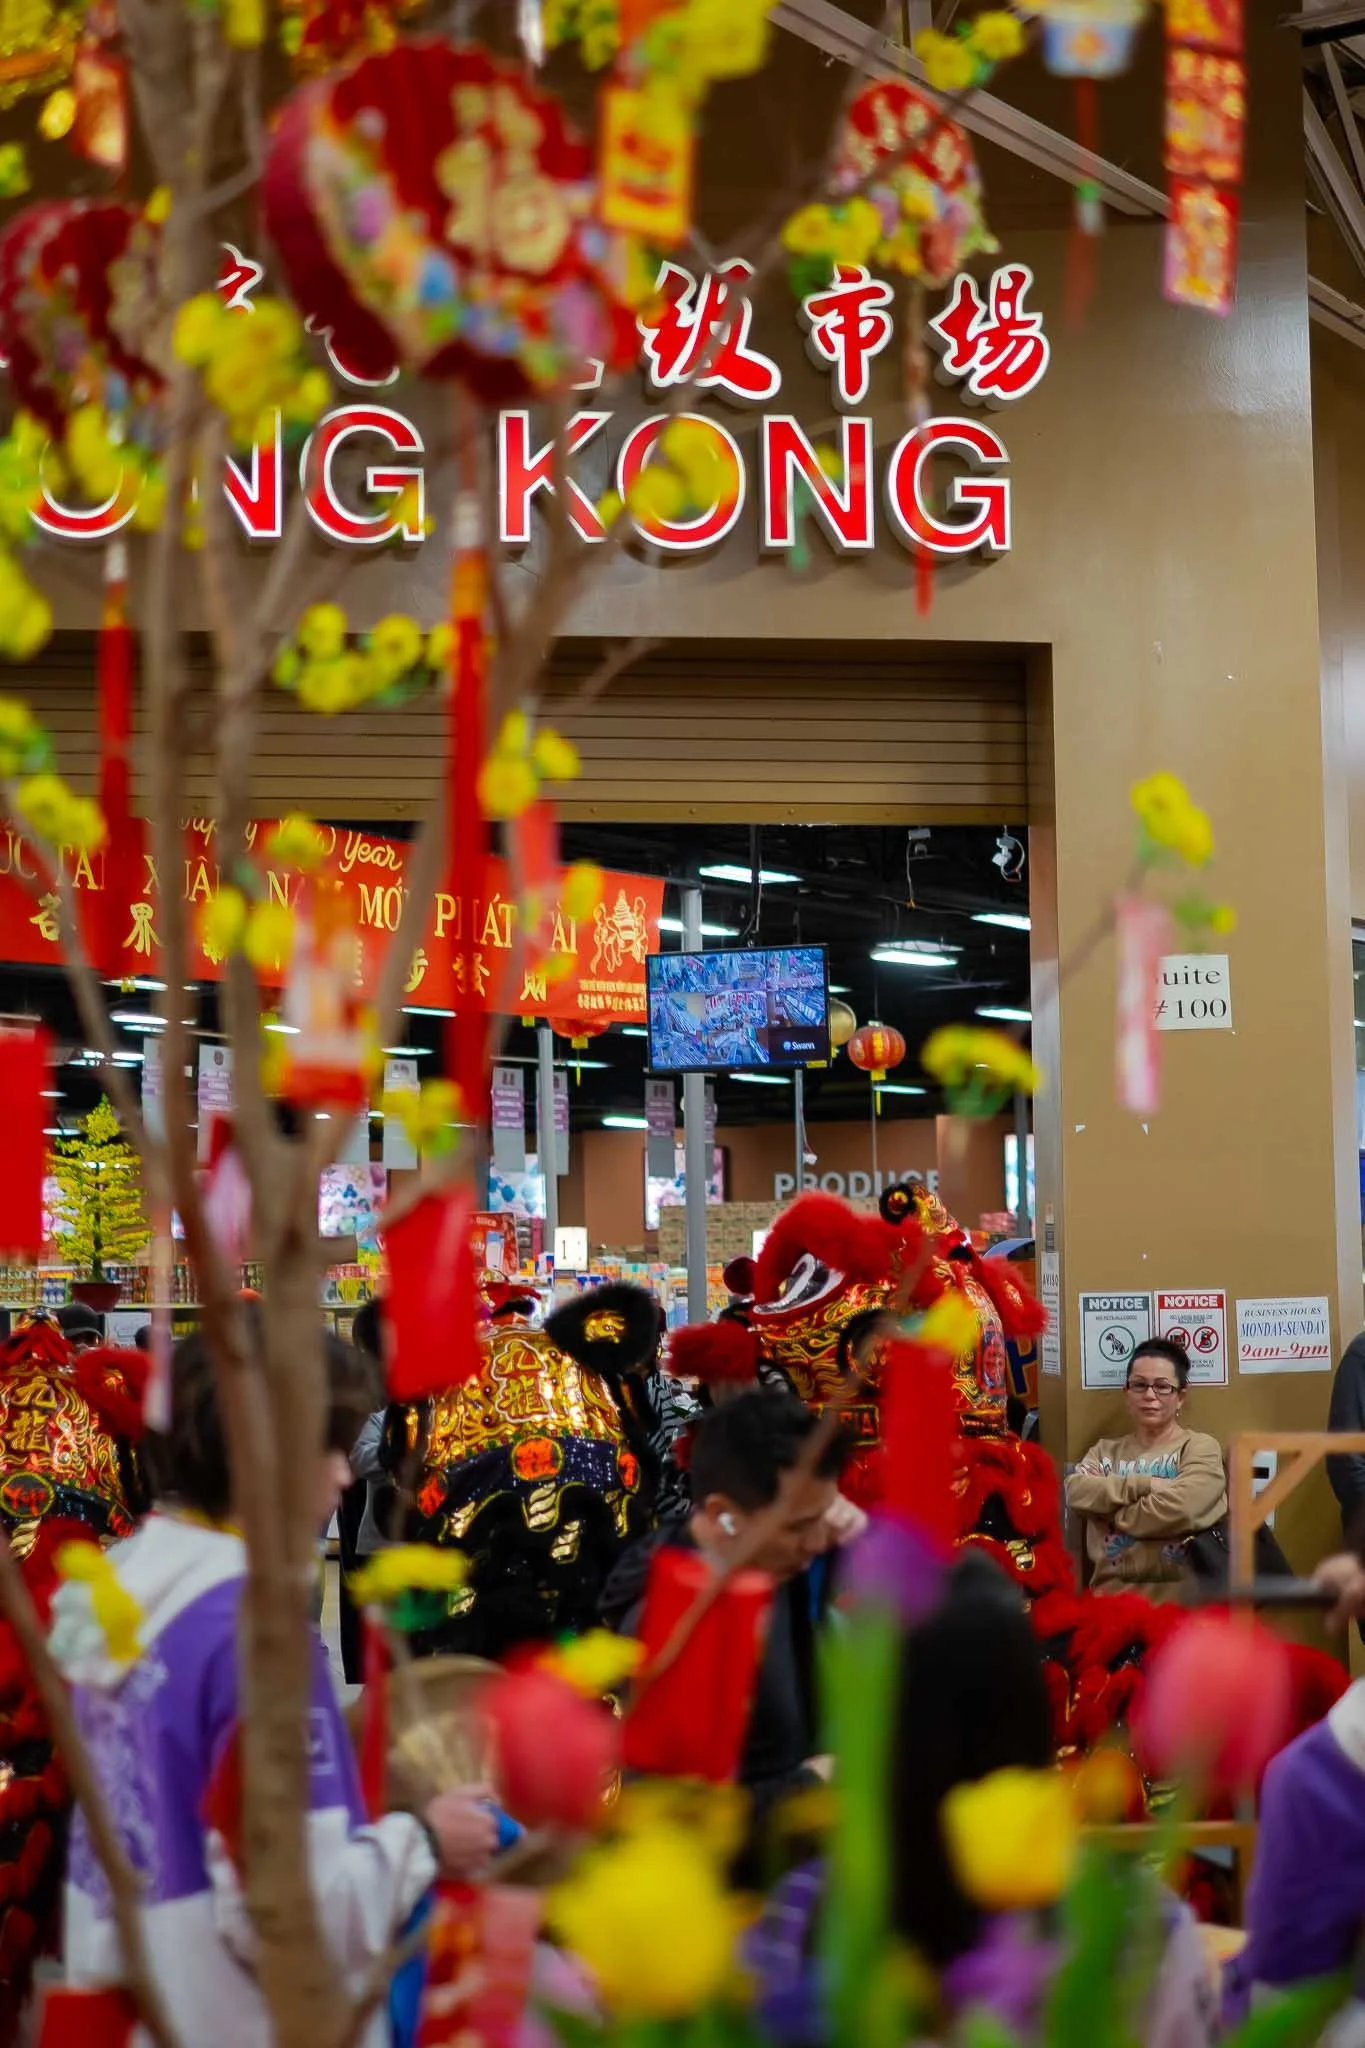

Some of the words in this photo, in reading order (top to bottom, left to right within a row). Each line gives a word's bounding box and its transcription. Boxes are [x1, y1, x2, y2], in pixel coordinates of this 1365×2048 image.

[499, 409, 1013, 554] KONG
[339, 830, 402, 873] Year
[1155, 964, 1222, 986] uite
[1088, 1297, 1144, 1310] NOTICE
[1164, 1295, 1218, 1308] NOTICE
[1241, 1319, 1327, 1337] MONDAY-SUNDAY
